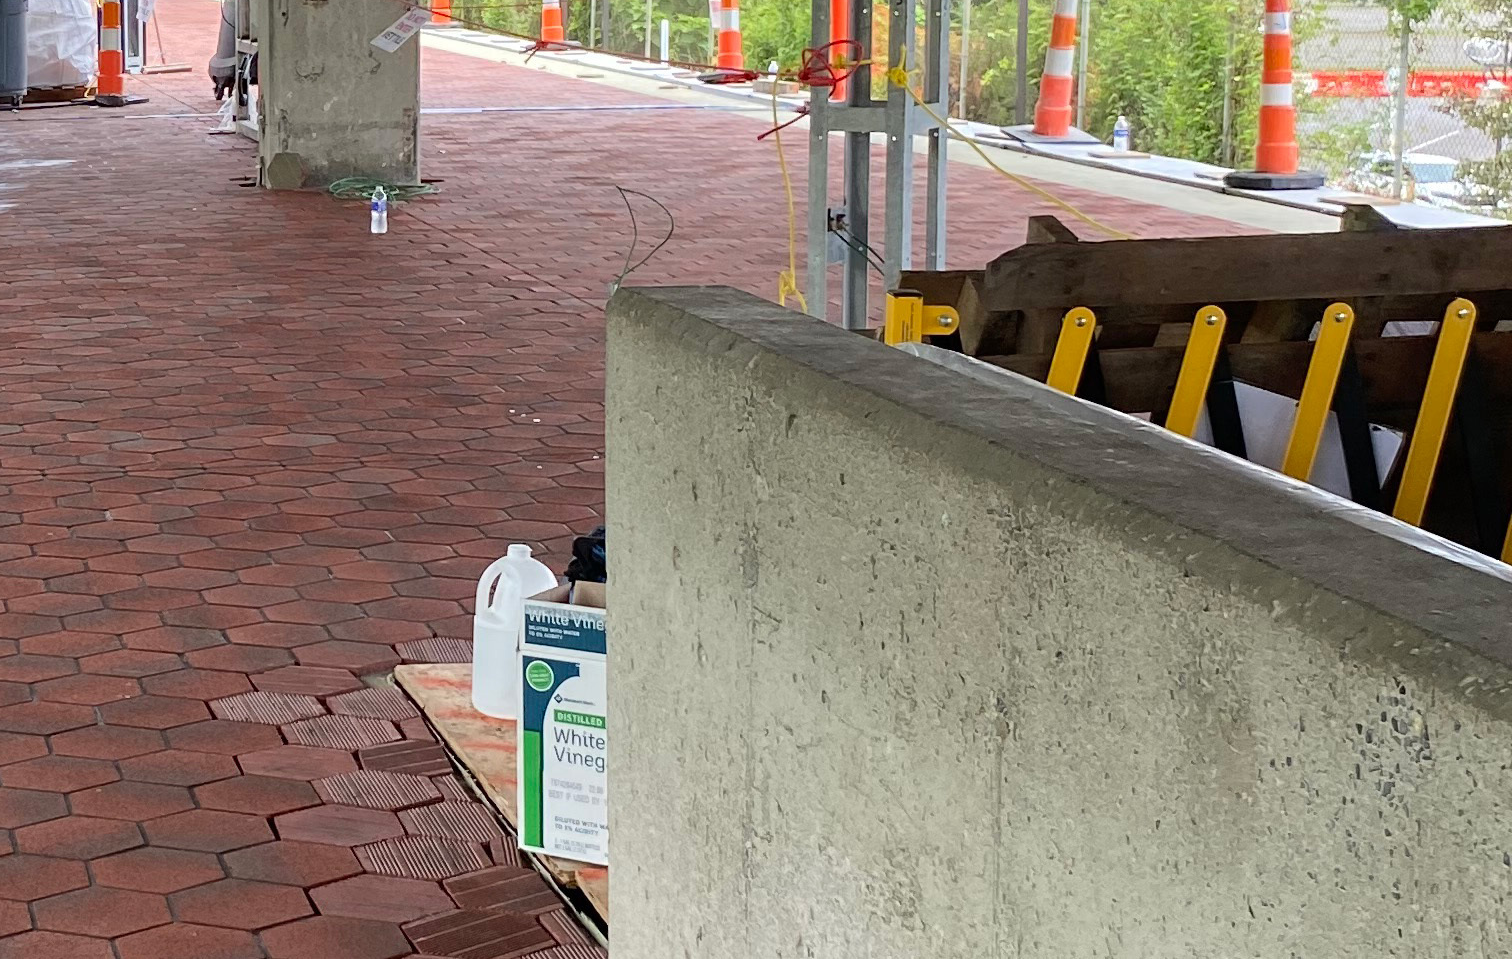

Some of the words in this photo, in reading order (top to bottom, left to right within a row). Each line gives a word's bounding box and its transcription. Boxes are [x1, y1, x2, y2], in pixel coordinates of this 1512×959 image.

[528, 608, 569, 626] White
[571, 612, 606, 633] Vine
[557, 711, 603, 726] DISTILLED
[554, 726, 605, 750] White
[554, 745, 605, 773] Vineg
